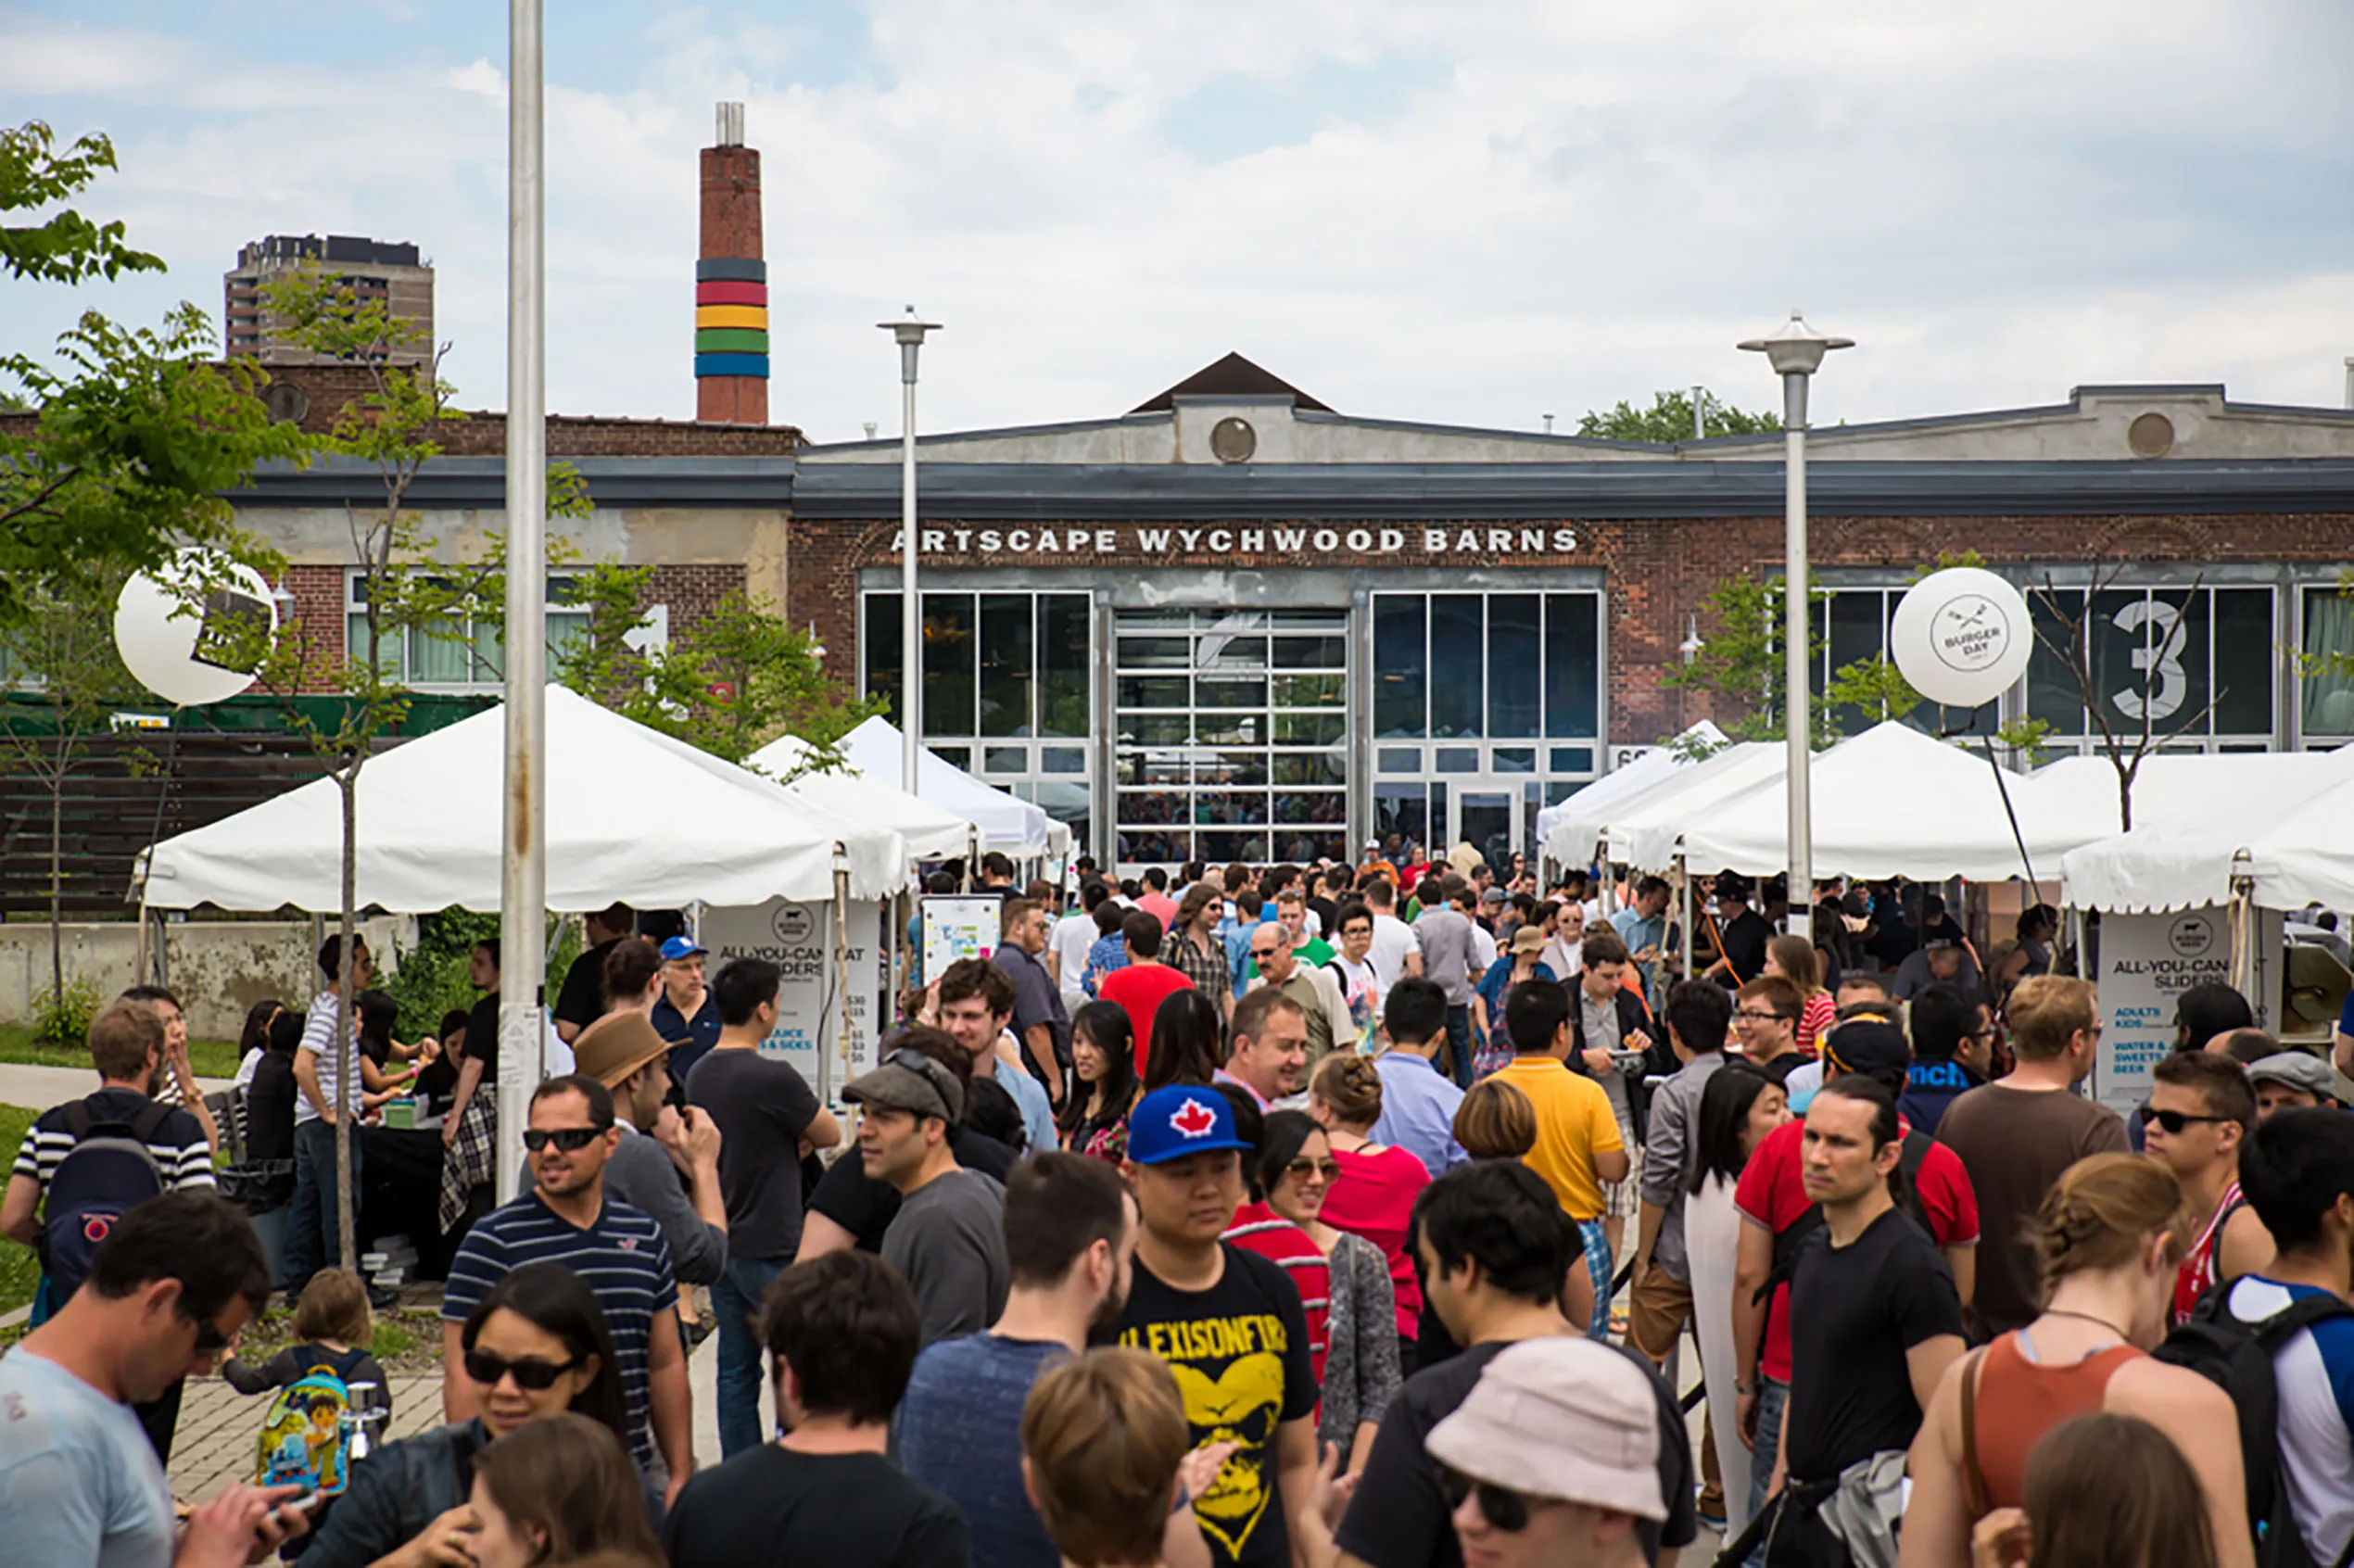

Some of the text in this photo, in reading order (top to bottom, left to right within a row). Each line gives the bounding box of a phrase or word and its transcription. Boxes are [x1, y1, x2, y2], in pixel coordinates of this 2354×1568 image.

[891, 528, 1576, 552] ARTSCAPE WYCHWOOD BARNS
[1944, 626, 2000, 649] BURGER
[1963, 640, 1989, 656] DAY
[2112, 600, 2187, 720] 3
[2113, 959, 2229, 975] ALL-YOU-CAN
[2115, 1006, 2161, 1018] ADULTS
[2115, 1019, 2143, 1029] KIDS
[2114, 1041, 2155, 1051] WATER
[2114, 1052, 2163, 1062] SWEETS
[2113, 1064, 2145, 1074] BEER
